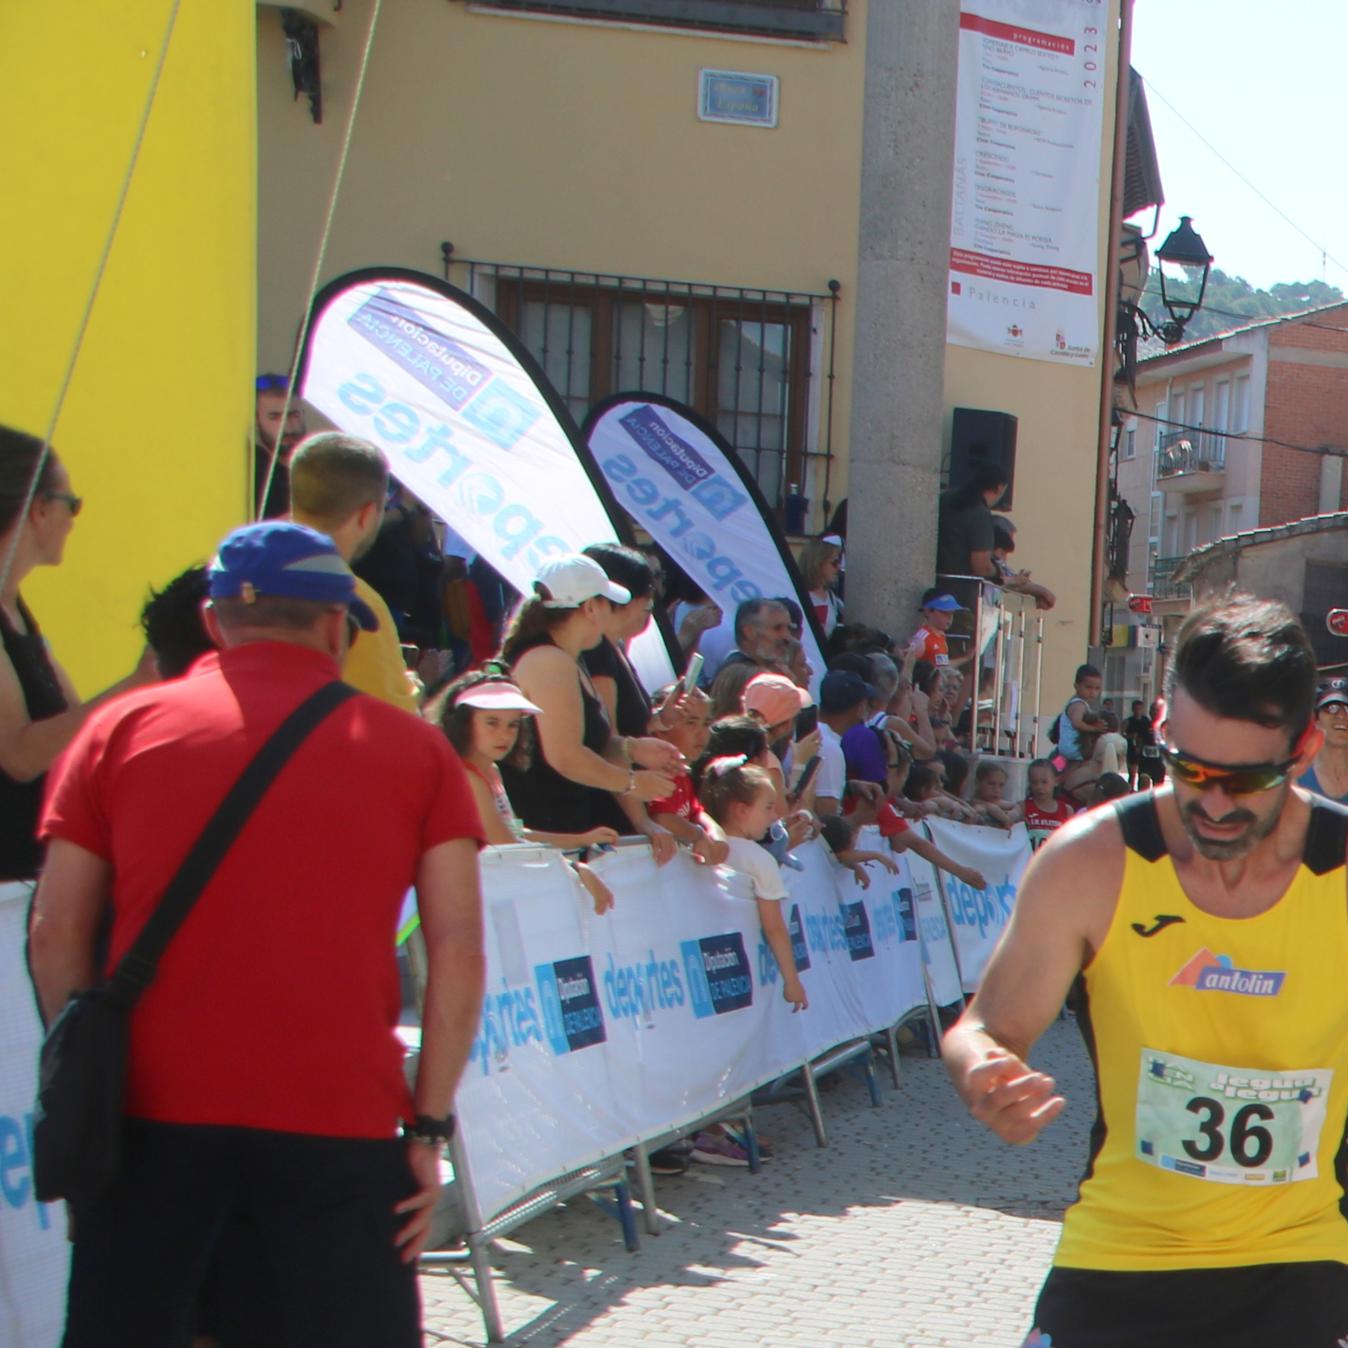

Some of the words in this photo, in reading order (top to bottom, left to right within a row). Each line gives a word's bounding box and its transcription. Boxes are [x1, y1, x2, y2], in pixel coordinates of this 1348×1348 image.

[1084, 26, 1098, 89] 2023
[968, 286, 1037, 310] Palencia
[1204, 969, 1276, 995] antolin
[1181, 1096, 1276, 1168] 36
